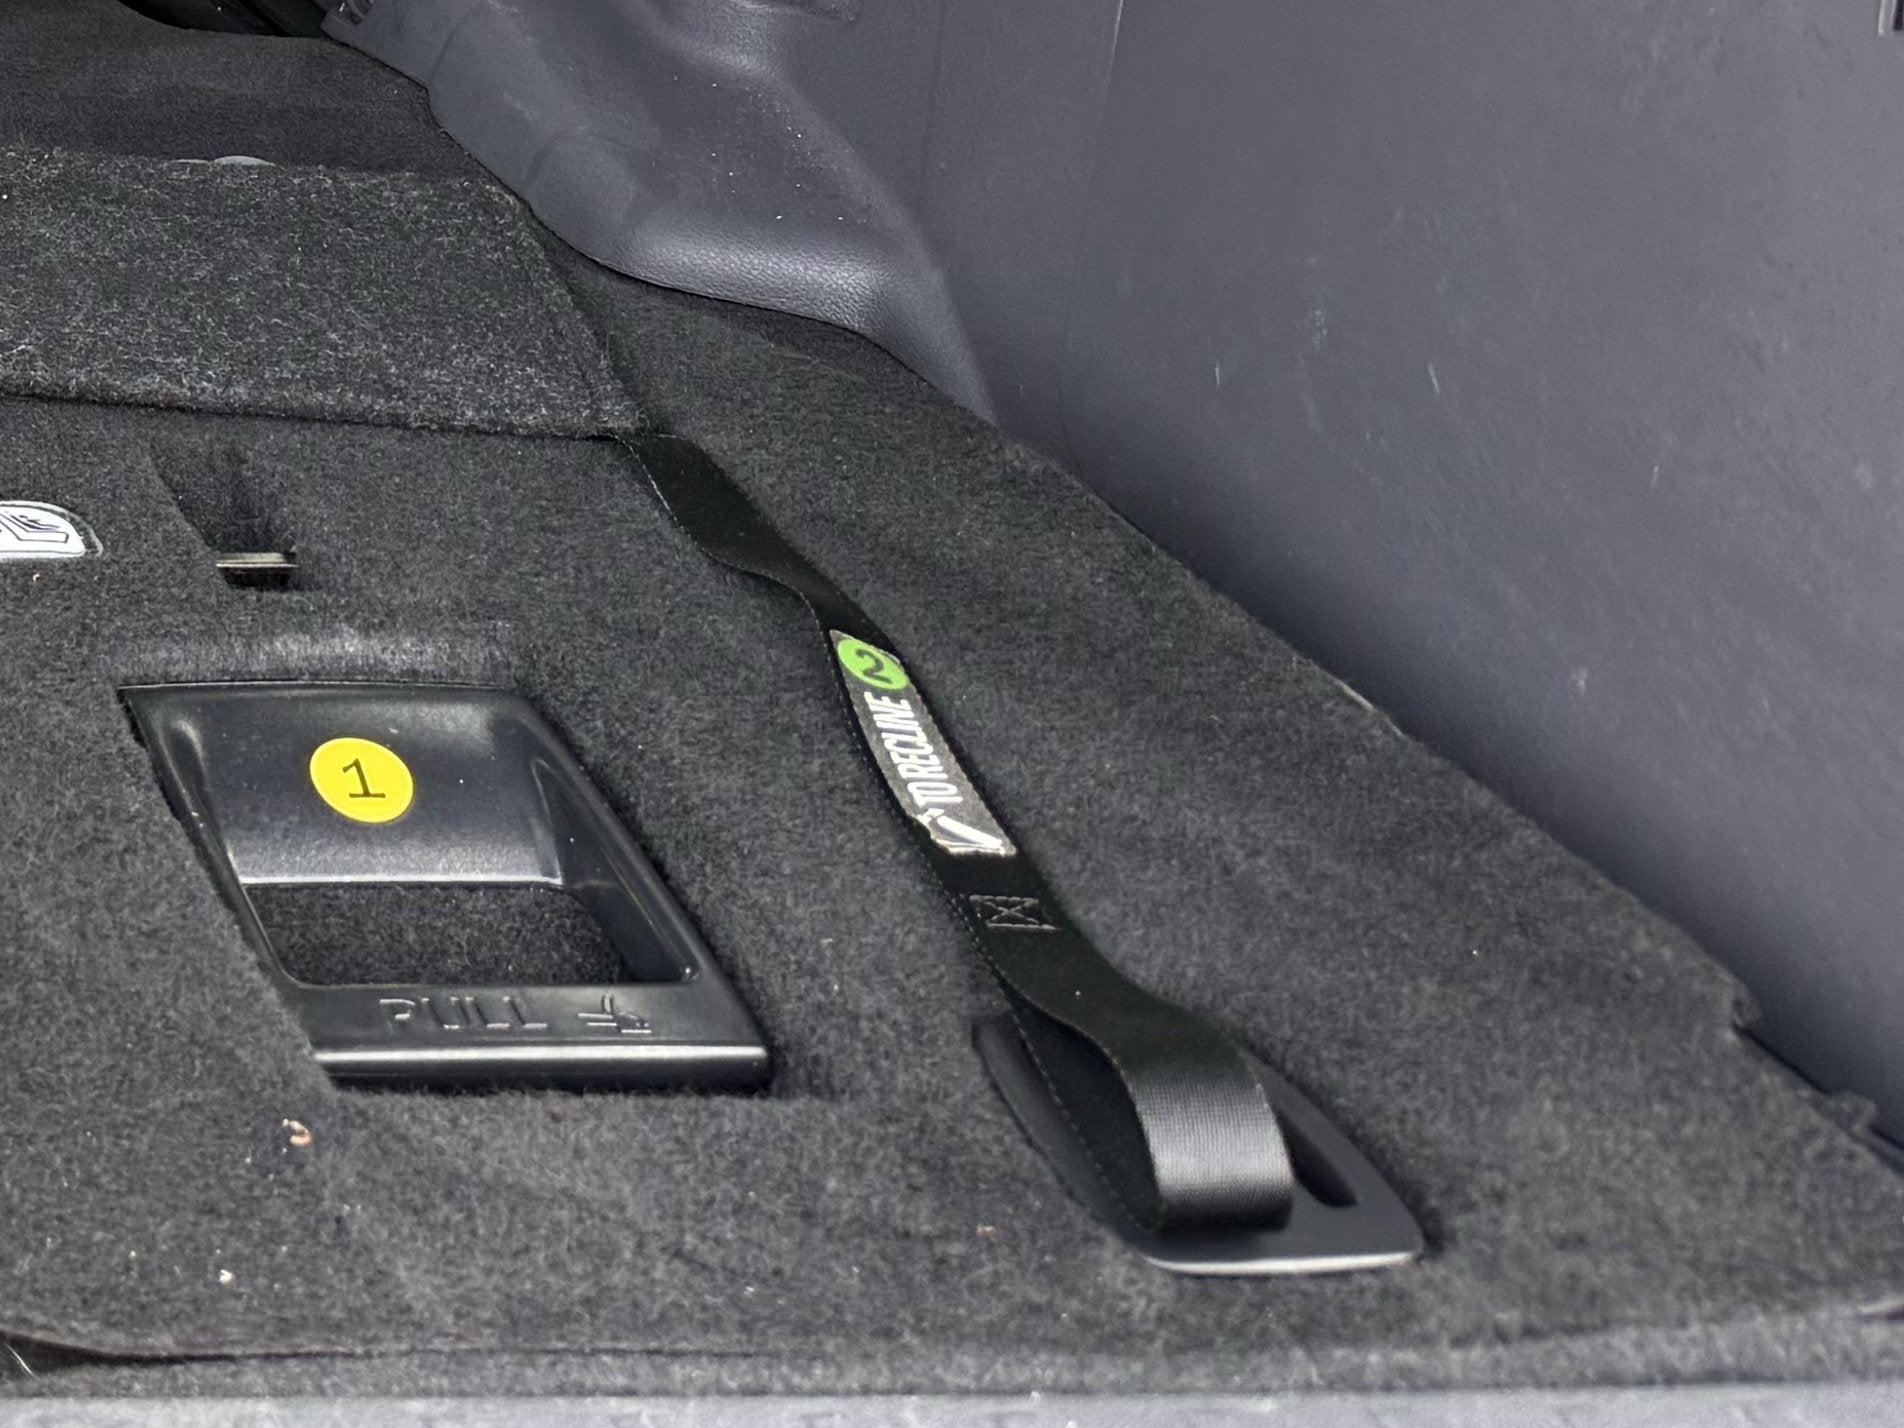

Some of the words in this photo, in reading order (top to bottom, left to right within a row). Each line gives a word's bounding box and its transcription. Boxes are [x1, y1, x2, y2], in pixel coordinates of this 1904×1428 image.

[856, 649, 892, 683] 2
[864, 691, 951, 784] RECLINE
[341, 757, 386, 800] 1
[907, 777, 964, 808] TO
